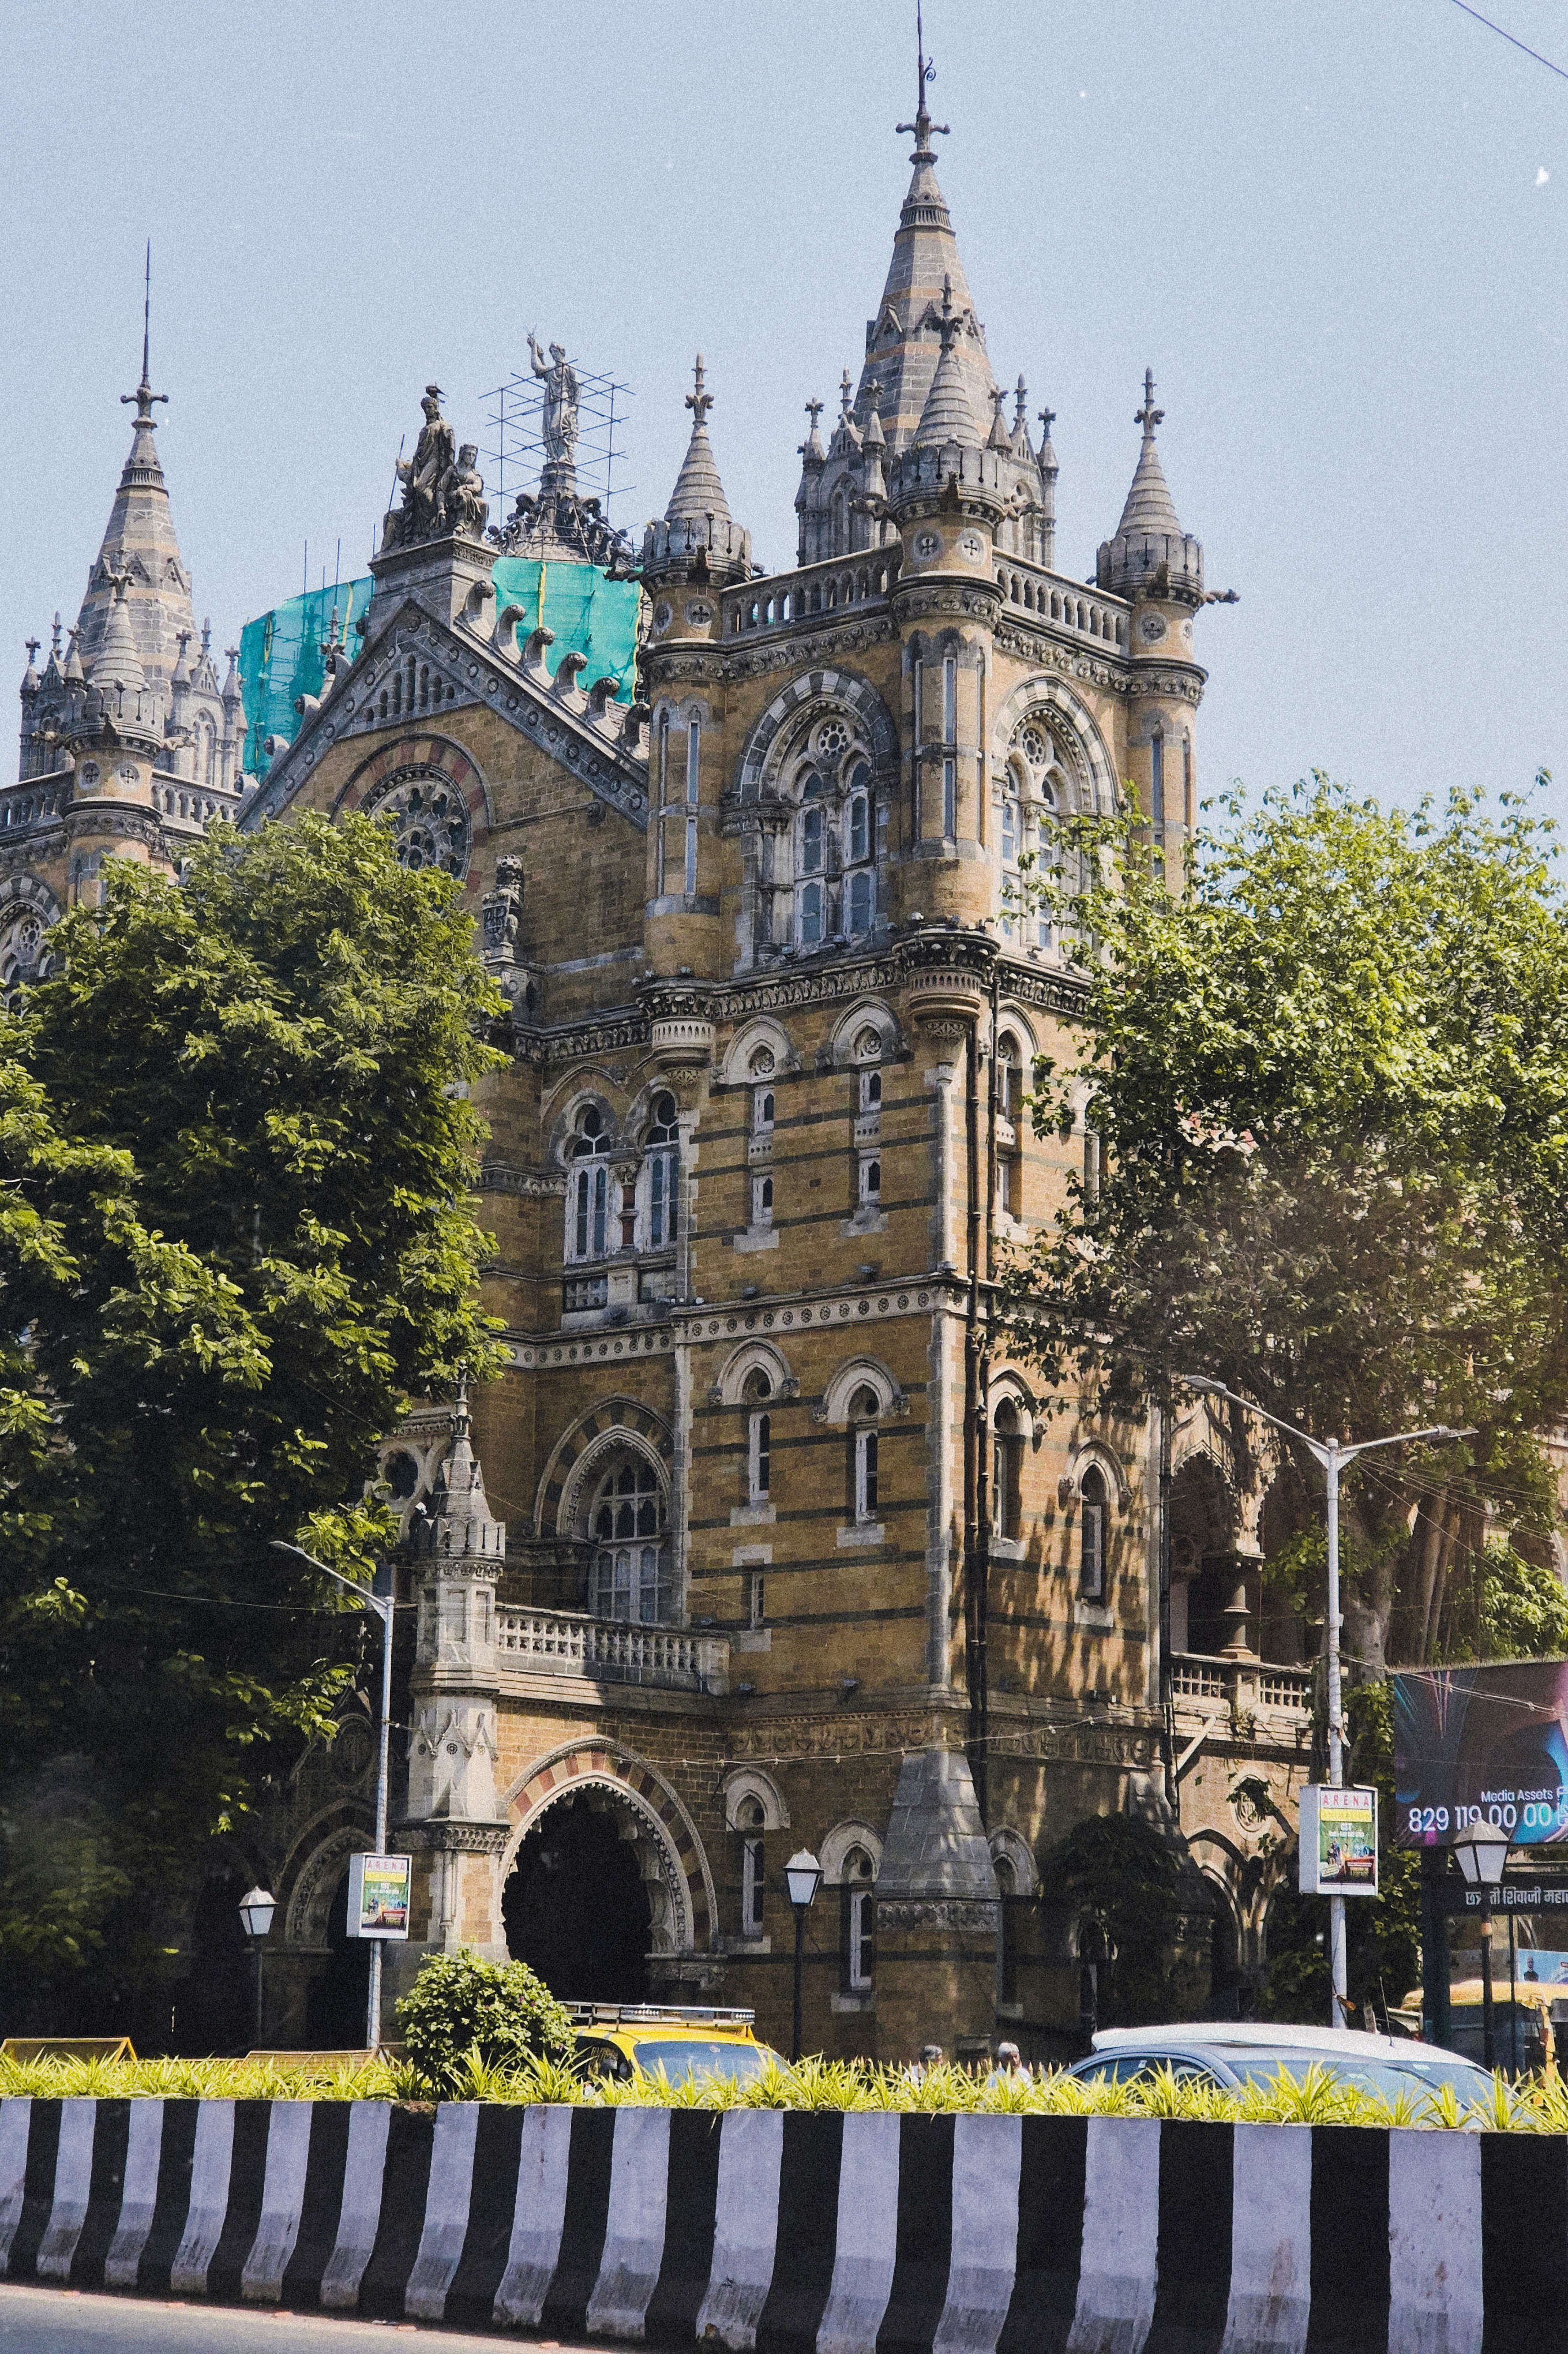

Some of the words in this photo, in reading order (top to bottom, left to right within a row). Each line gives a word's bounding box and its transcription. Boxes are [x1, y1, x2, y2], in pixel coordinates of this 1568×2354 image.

[1323, 1795, 1369, 1806] ARENA
[1481, 1789, 1515, 1802] Media
[1518, 1789, 1554, 1801] Assets
[1409, 1808, 1449, 1832] 829
[1488, 1804, 1517, 1828] 00
[1524, 1802, 1552, 1827] 00
[367, 1860, 404, 1870] ARENA
[1503, 1887, 1541, 1905] शिवाजी
